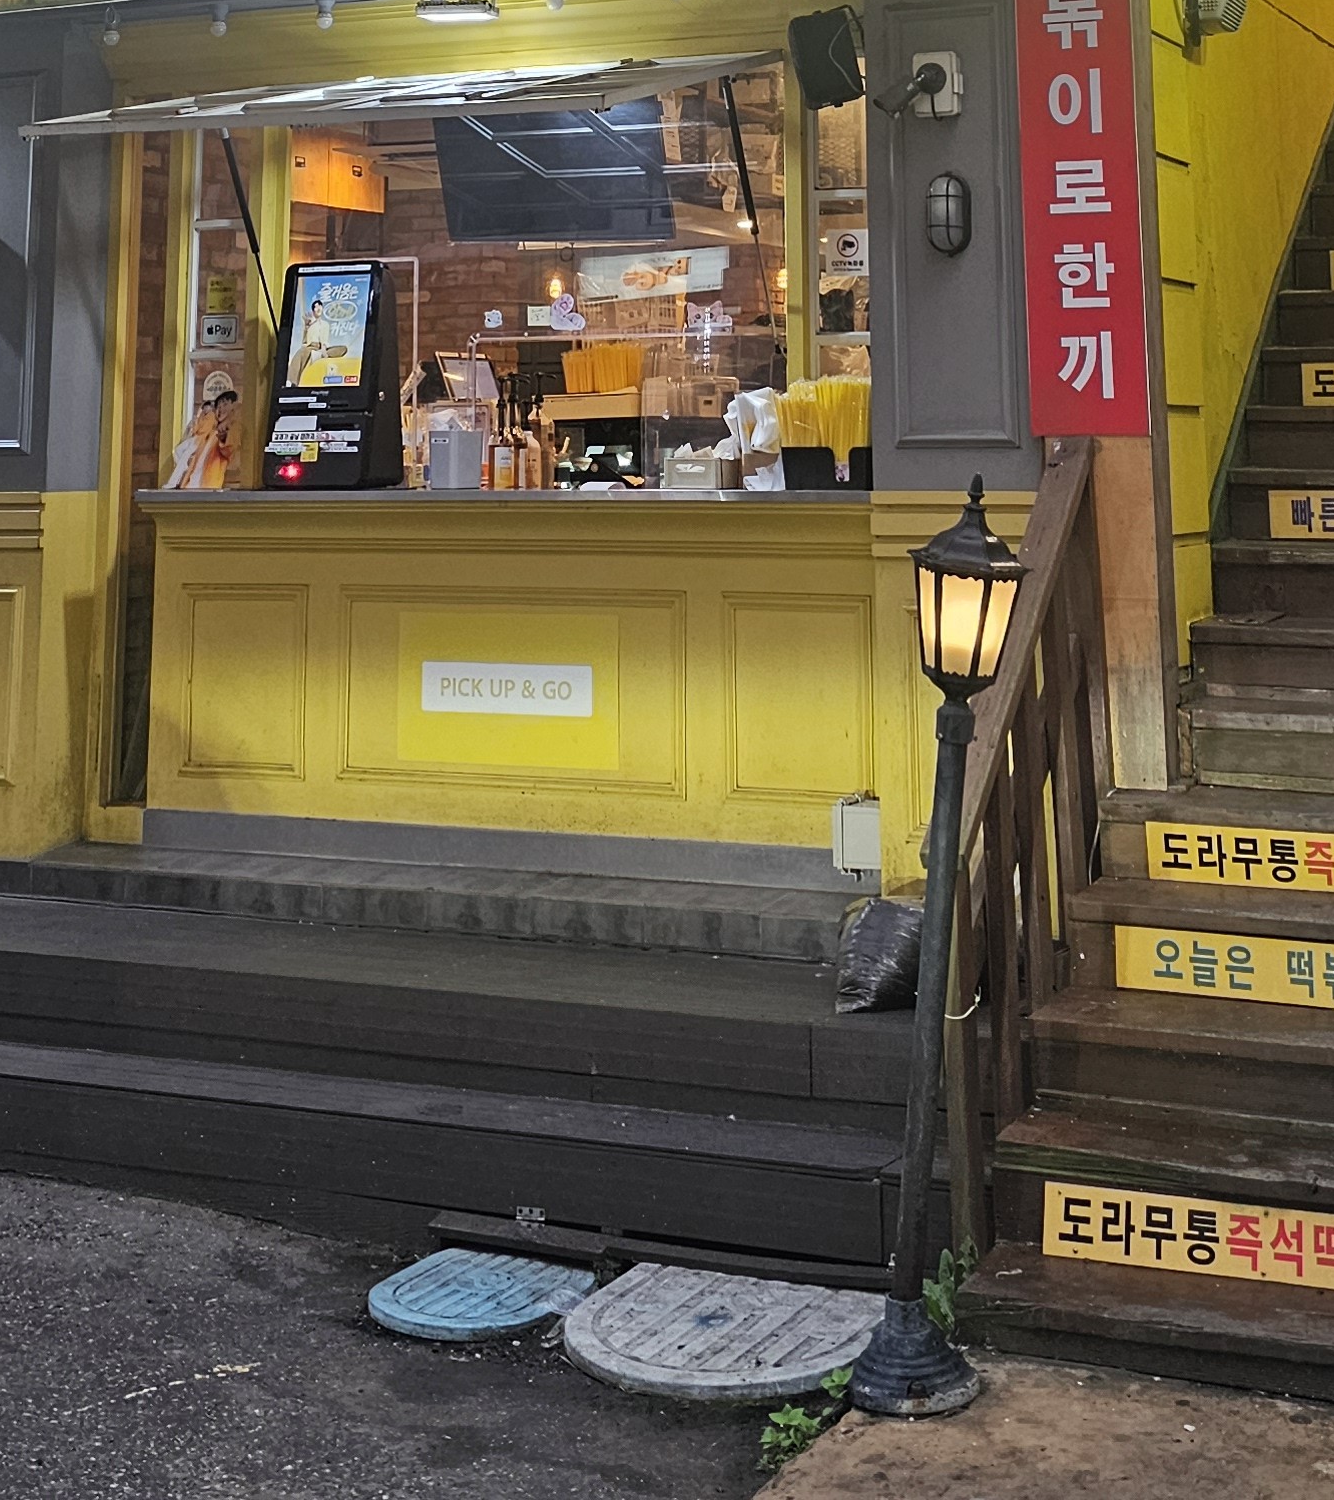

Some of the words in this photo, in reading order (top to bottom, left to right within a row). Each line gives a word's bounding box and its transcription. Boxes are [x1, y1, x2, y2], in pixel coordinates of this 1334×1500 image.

[214, 324, 232, 338] Pay
[440, 677, 484, 697] PICK
[490, 678, 516, 699] UP
[521, 679, 536, 699] &
[542, 680, 572, 700] GO
[1153, 939, 1254, 991] 오늘은
